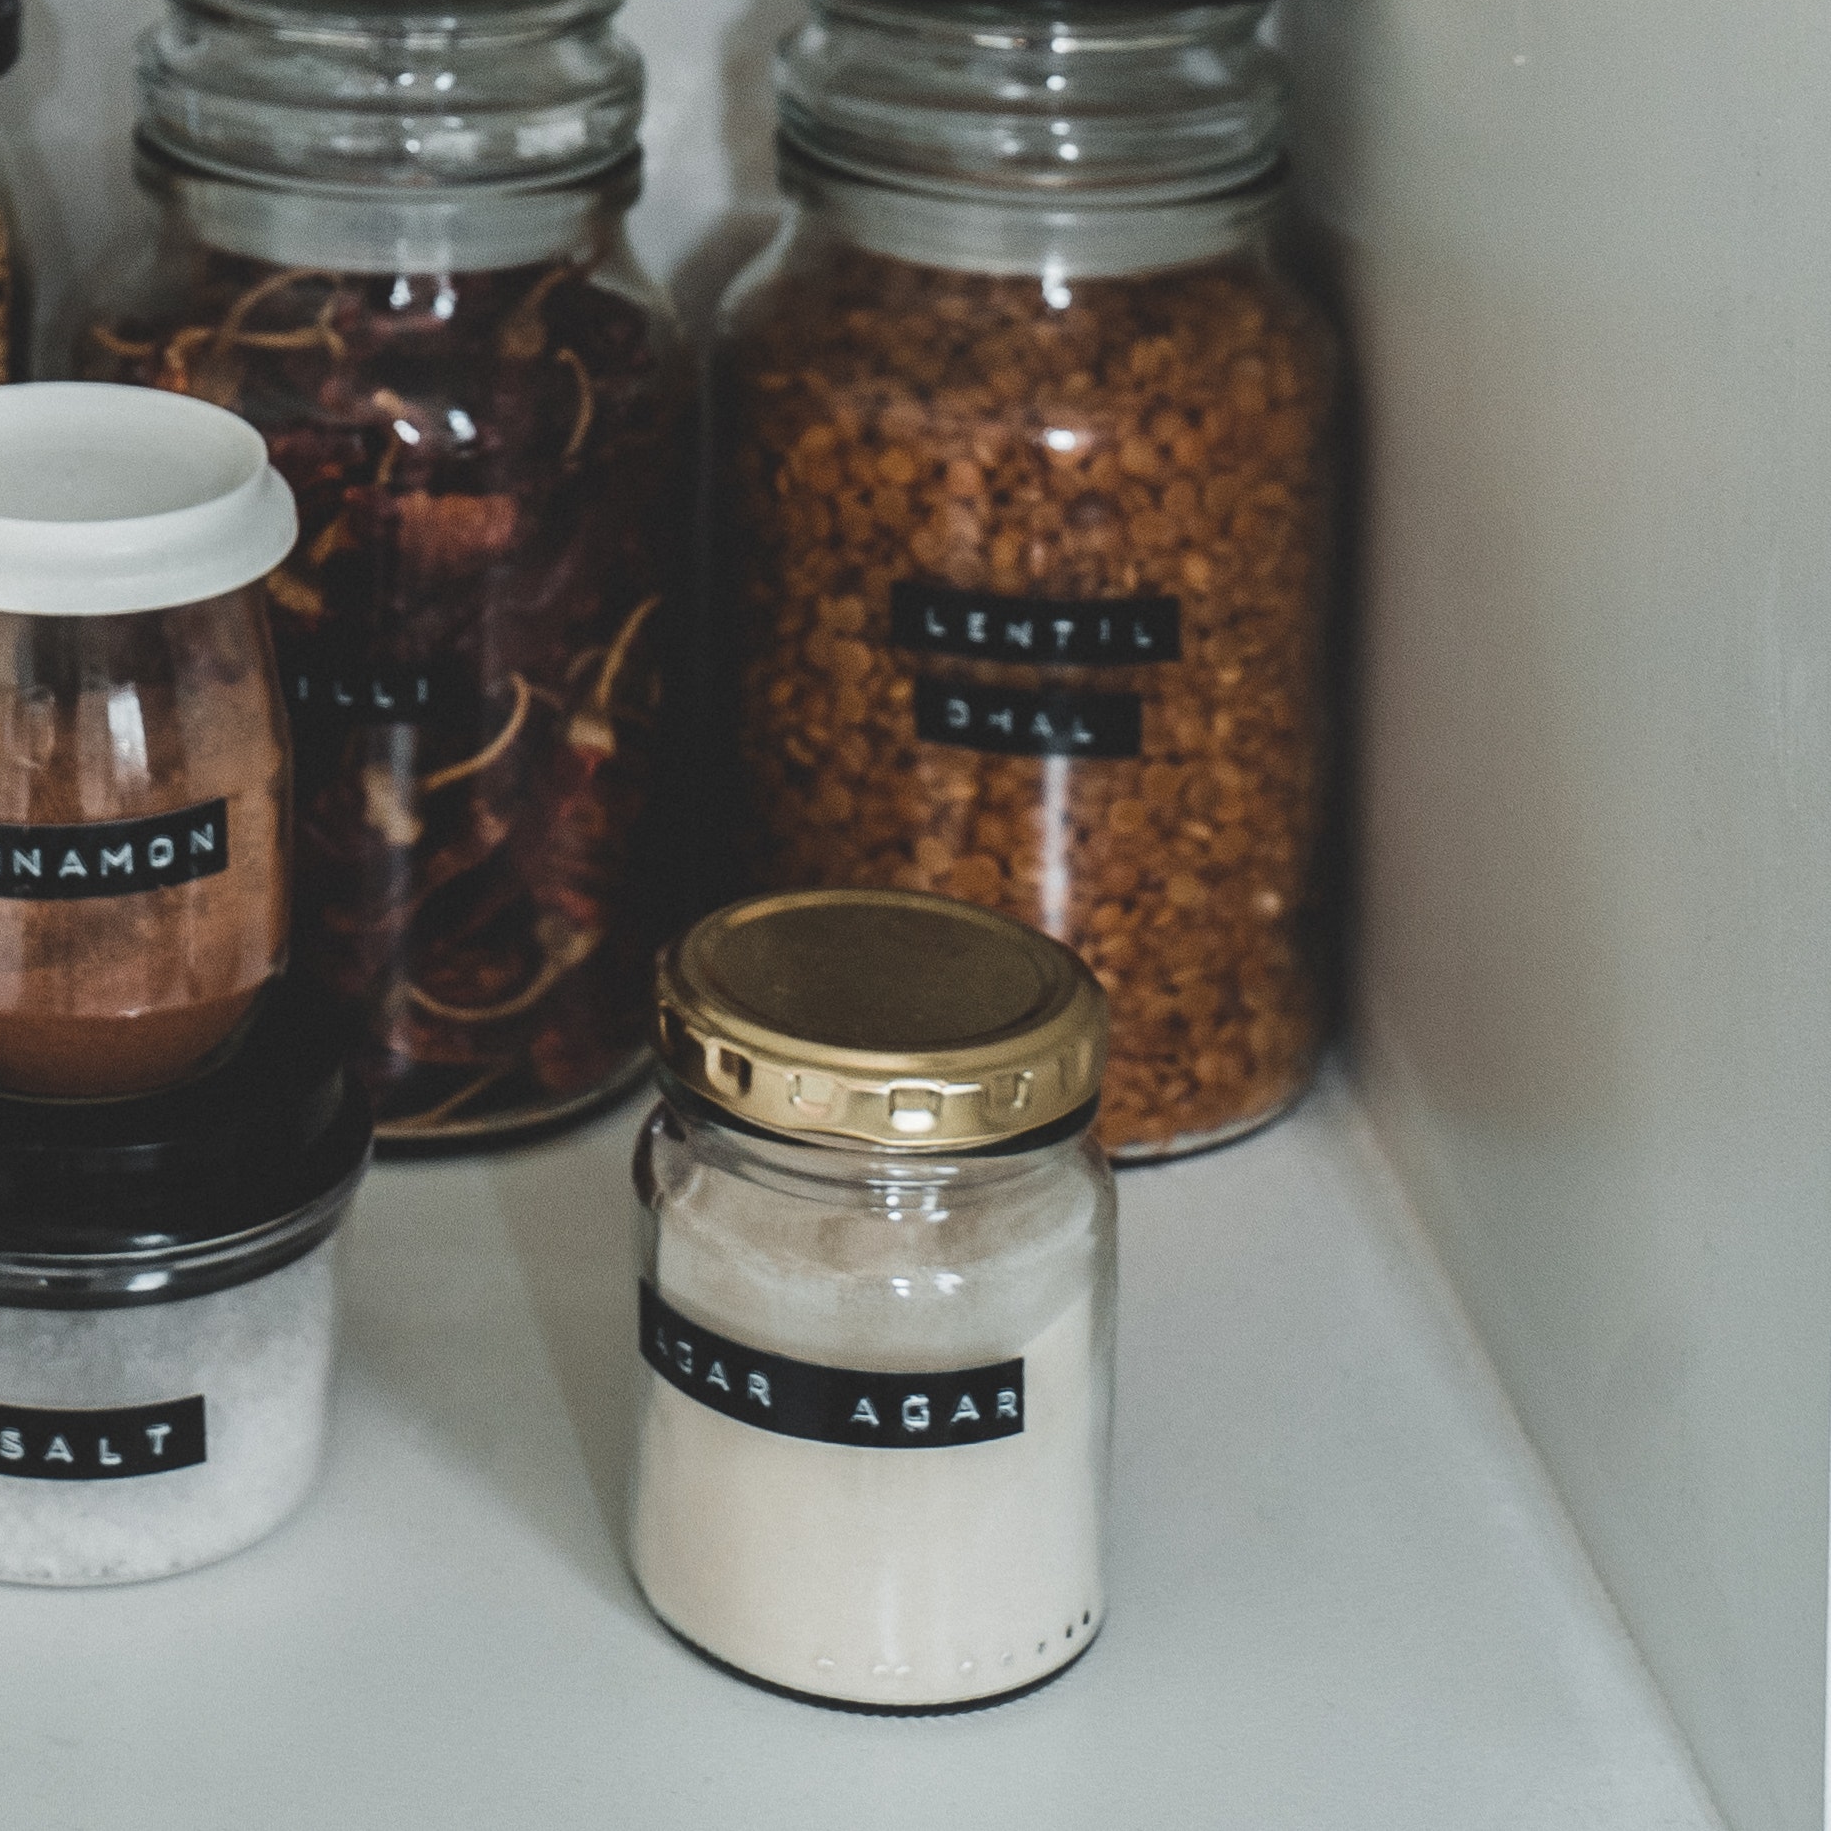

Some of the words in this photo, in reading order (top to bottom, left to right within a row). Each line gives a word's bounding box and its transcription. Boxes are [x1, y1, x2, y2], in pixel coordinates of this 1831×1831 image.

[925, 606, 1153, 649] LENTIL
[298, 676, 428, 708] ILLI
[654, 1324, 772, 1408] AGAR
[849, 1388, 1018, 1432] AGAR
